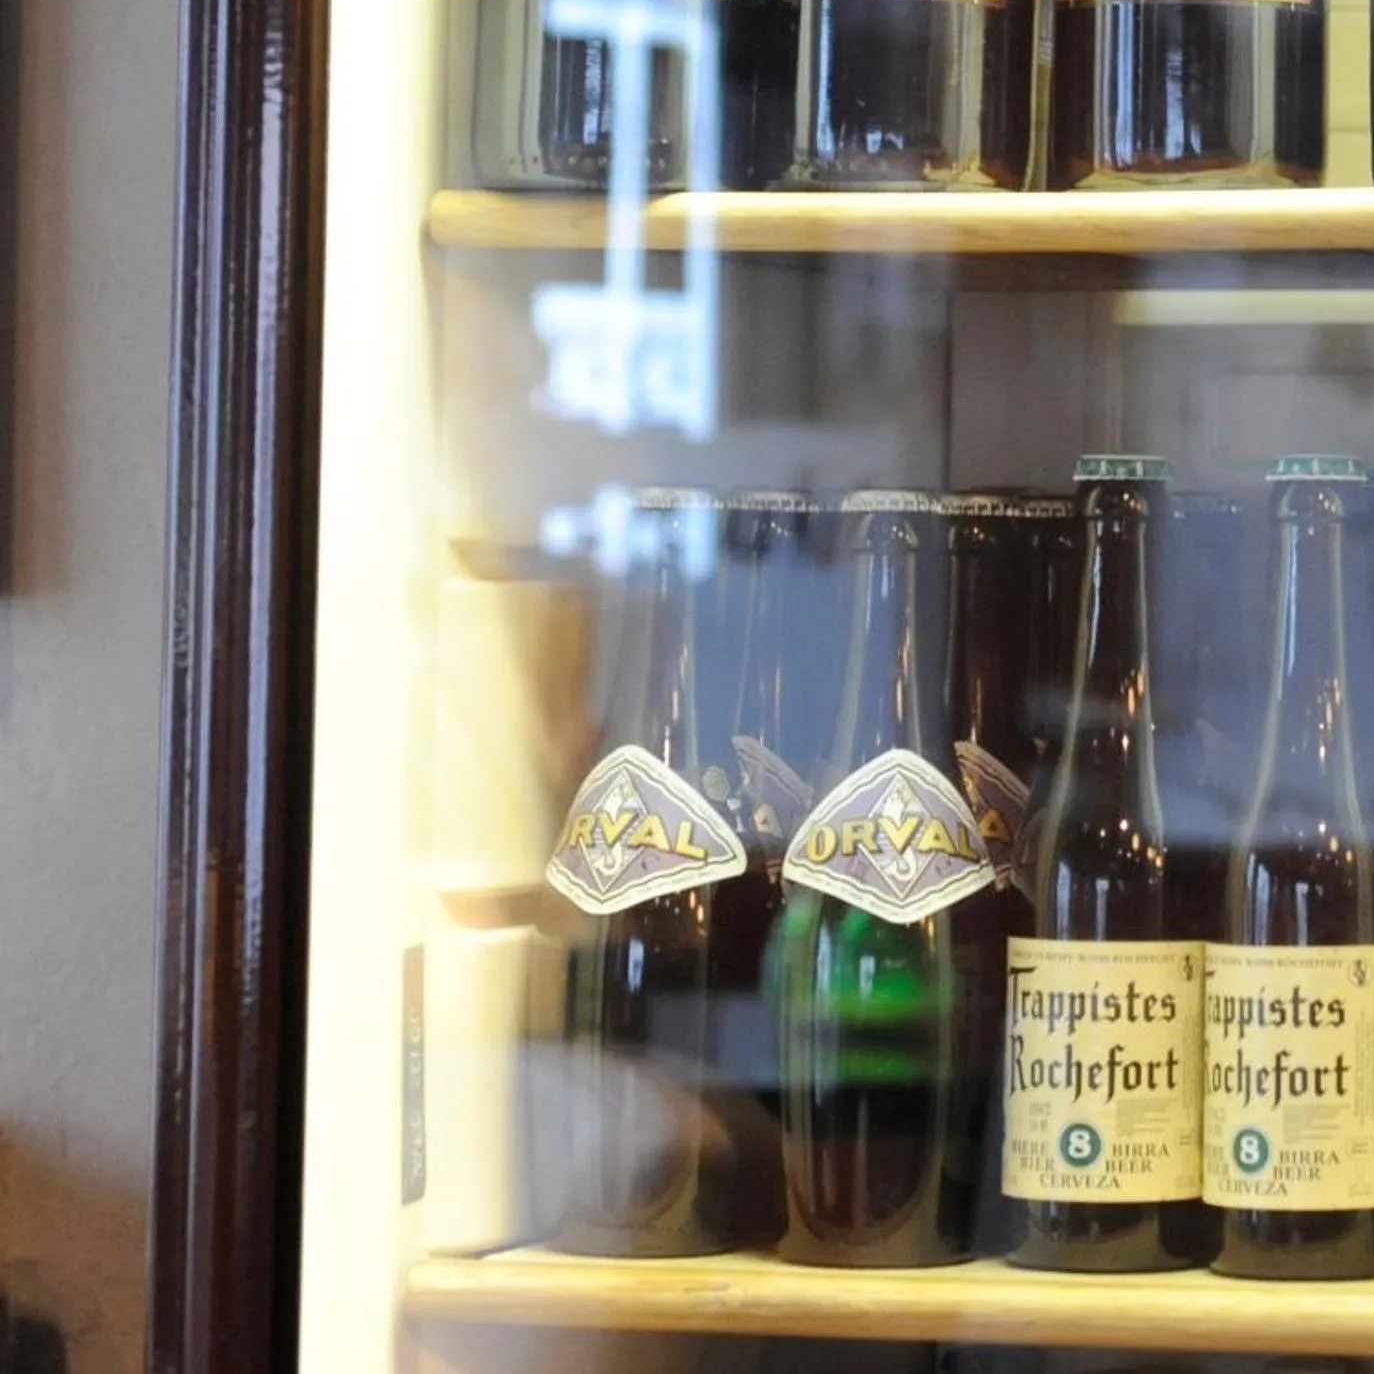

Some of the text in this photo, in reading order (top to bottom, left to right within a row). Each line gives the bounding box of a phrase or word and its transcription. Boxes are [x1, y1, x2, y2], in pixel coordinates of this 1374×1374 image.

[566, 812, 708, 861] RVAL
[805, 814, 981, 863] ORVAL
[1008, 966, 1177, 1035] Trappistes
[1010, 1033, 1179, 1104] Rochefort
[1068, 1129, 1092, 1159] 8
[1112, 1143, 1170, 1158] BIRRA
[1239, 1133, 1261, 1164] 8
[1105, 1157, 1153, 1173] BEER
[1279, 1149, 1340, 1165] BIRRA
[1040, 1174, 1120, 1189] CERVEZA
[1272, 1165, 1321, 1181] BEER
[1218, 1178, 1288, 1196] CERVEZA
